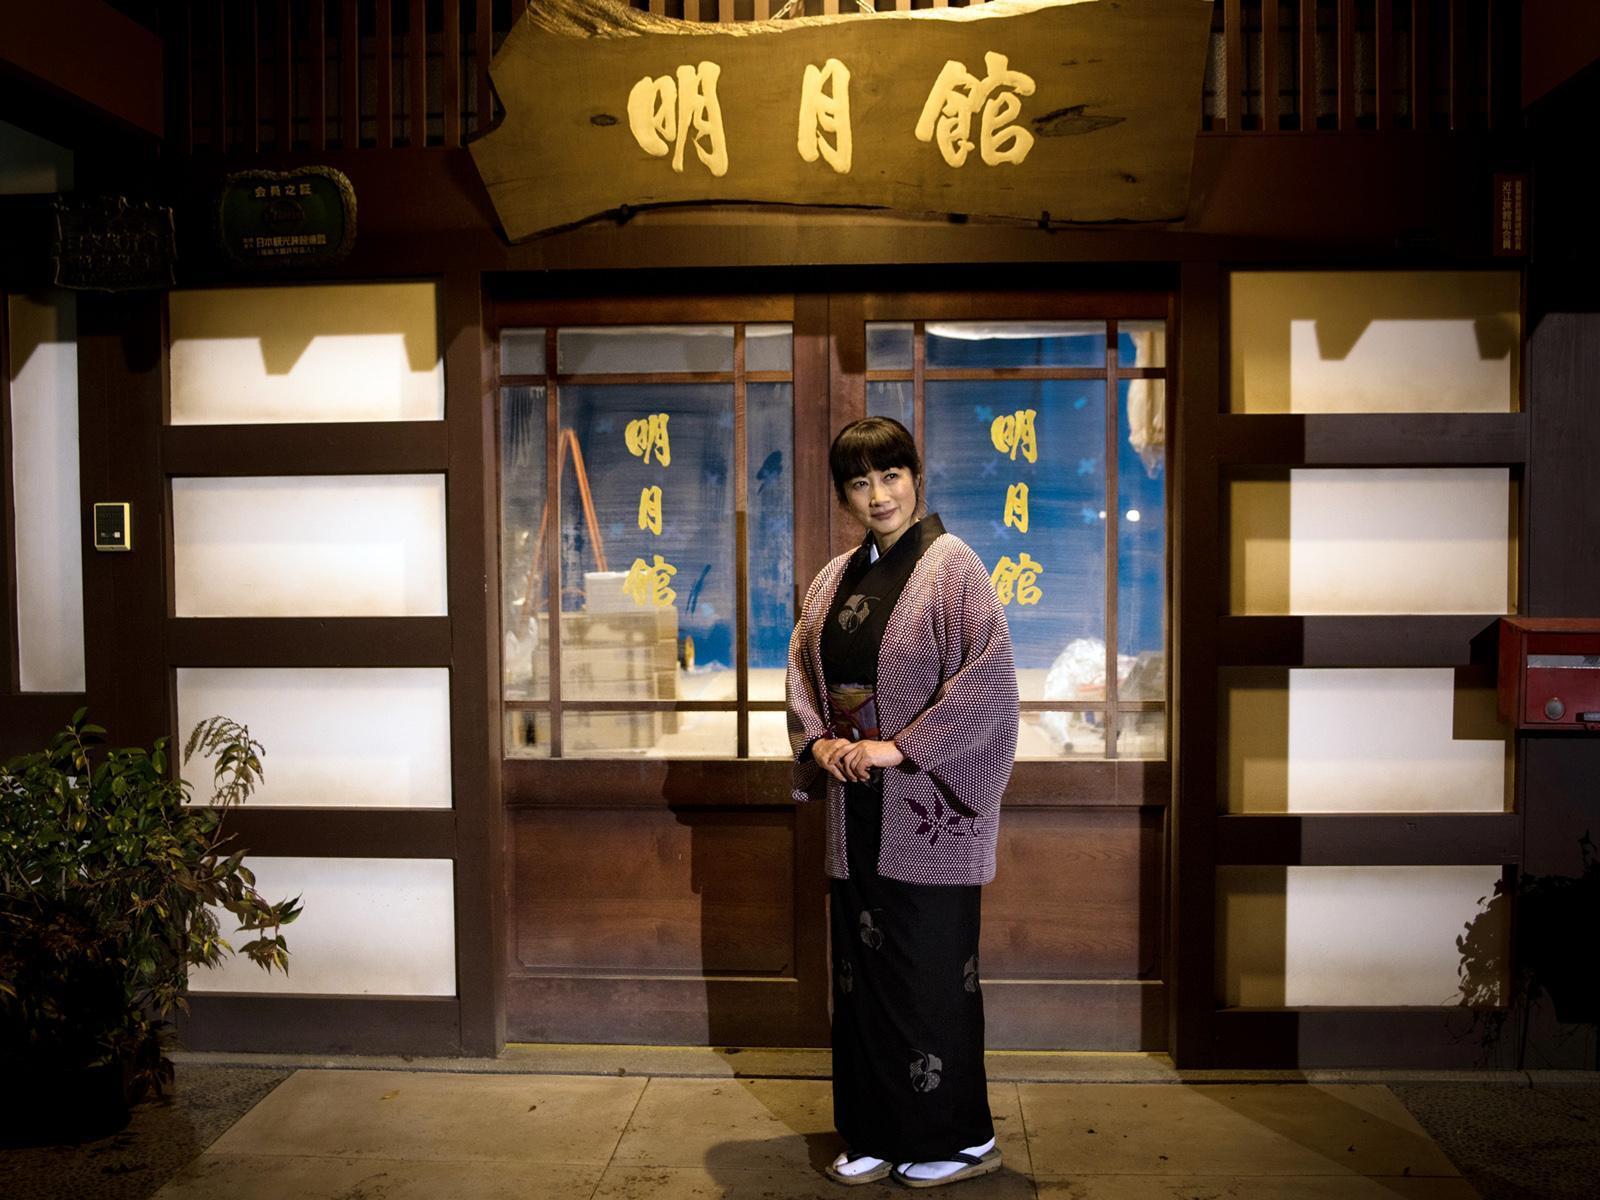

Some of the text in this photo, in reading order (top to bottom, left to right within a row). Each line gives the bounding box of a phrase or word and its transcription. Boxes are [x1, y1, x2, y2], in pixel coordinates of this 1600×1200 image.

[627, 51, 1037, 177] 明月館
[623, 413, 678, 608] 明月館
[990, 409, 1044, 606] 明月館
